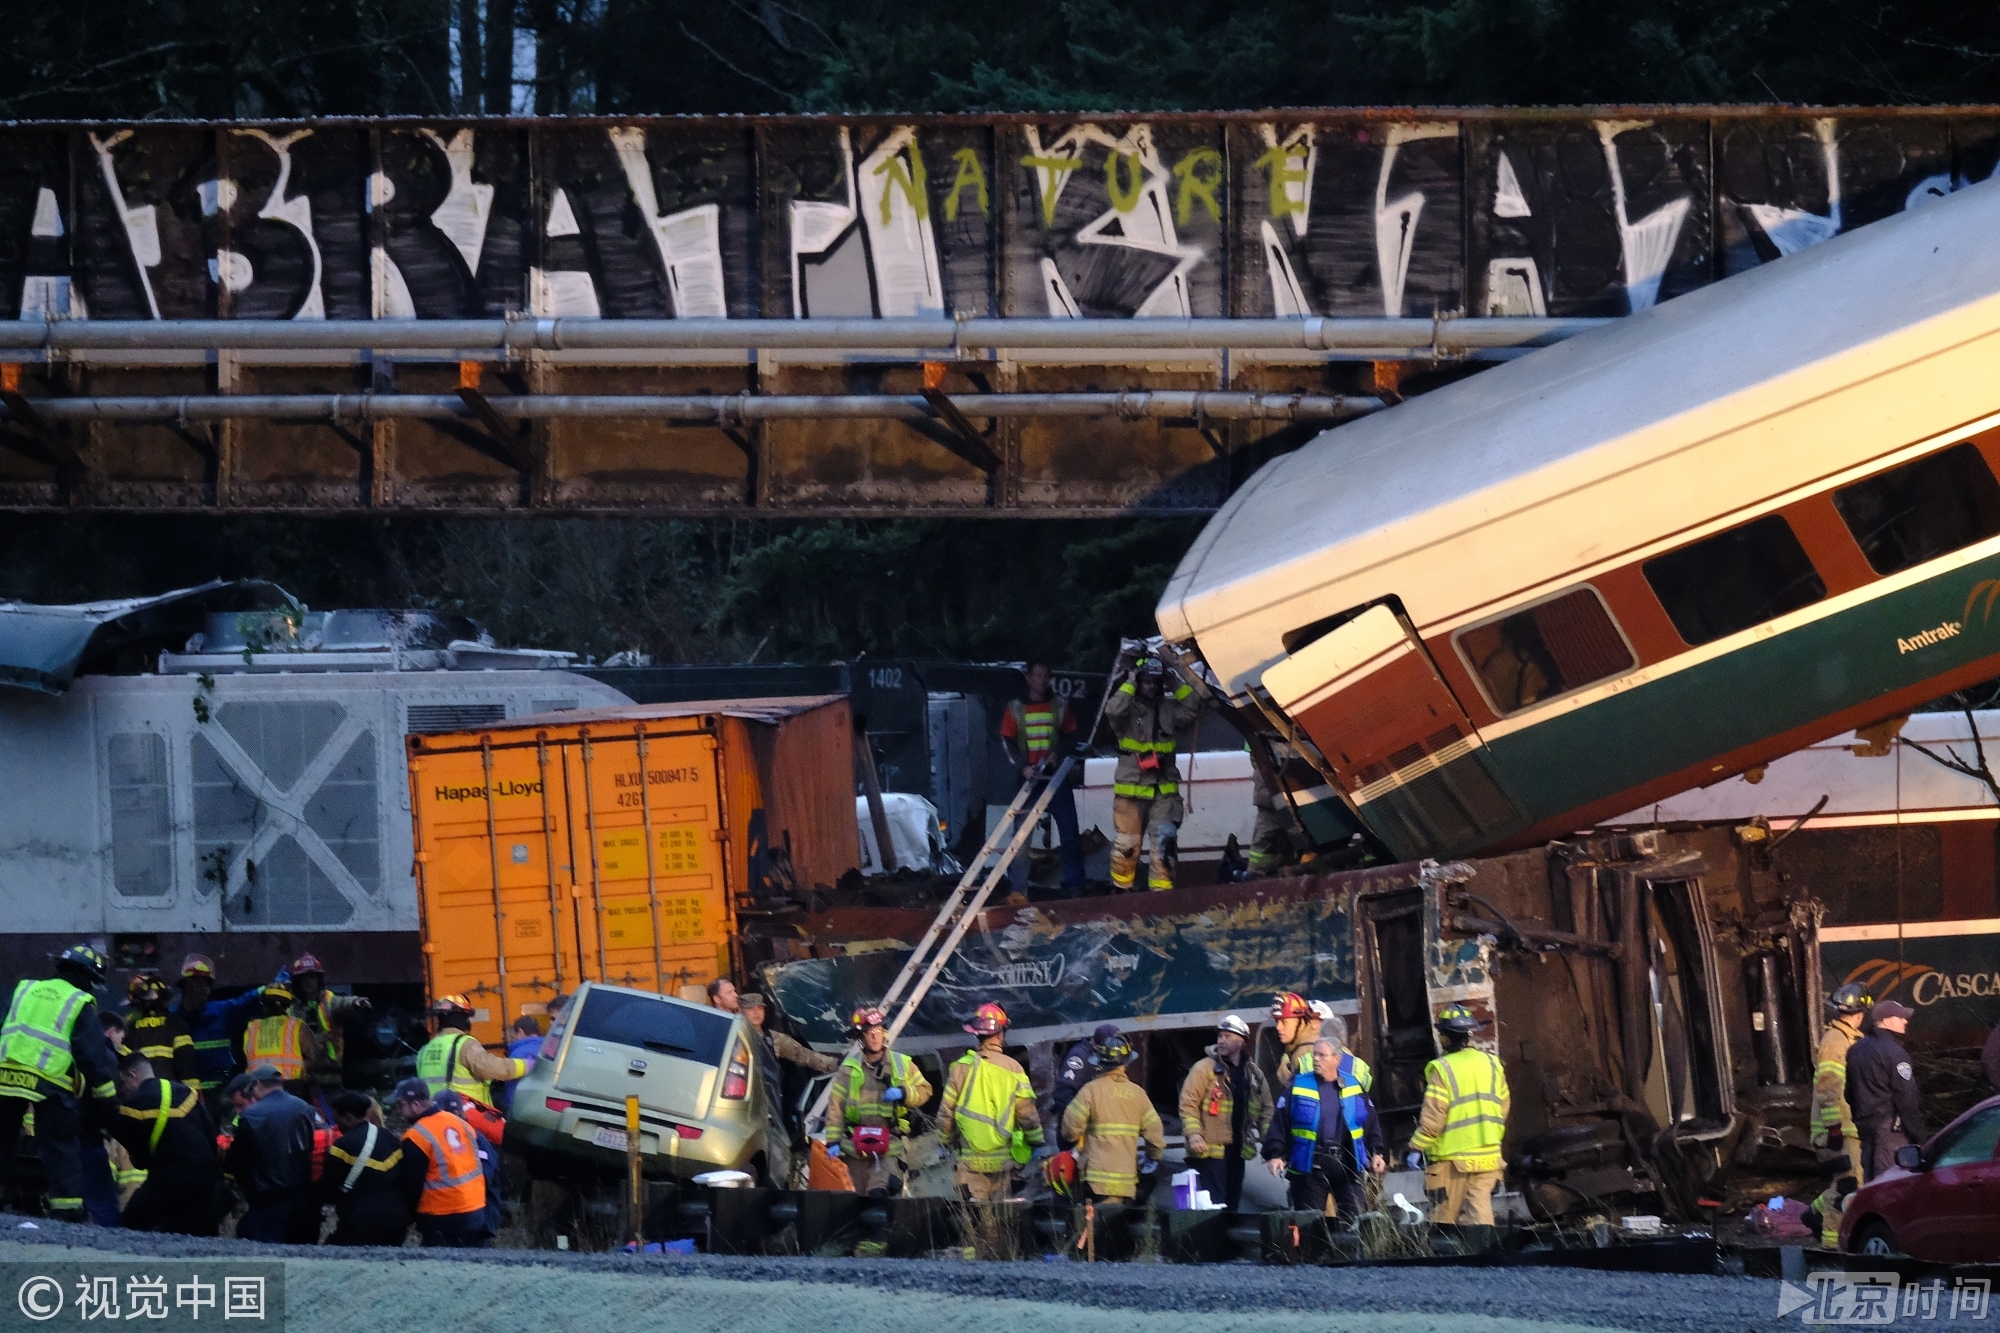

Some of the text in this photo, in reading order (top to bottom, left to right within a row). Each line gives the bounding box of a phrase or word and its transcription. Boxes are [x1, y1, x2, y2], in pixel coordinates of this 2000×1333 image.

[874, 138, 1309, 228] NATURE
[1896, 620, 1961, 655] Amtrak
[868, 667, 902, 689] 1402
[435, 779, 545, 803] Hapag-Lloyd
